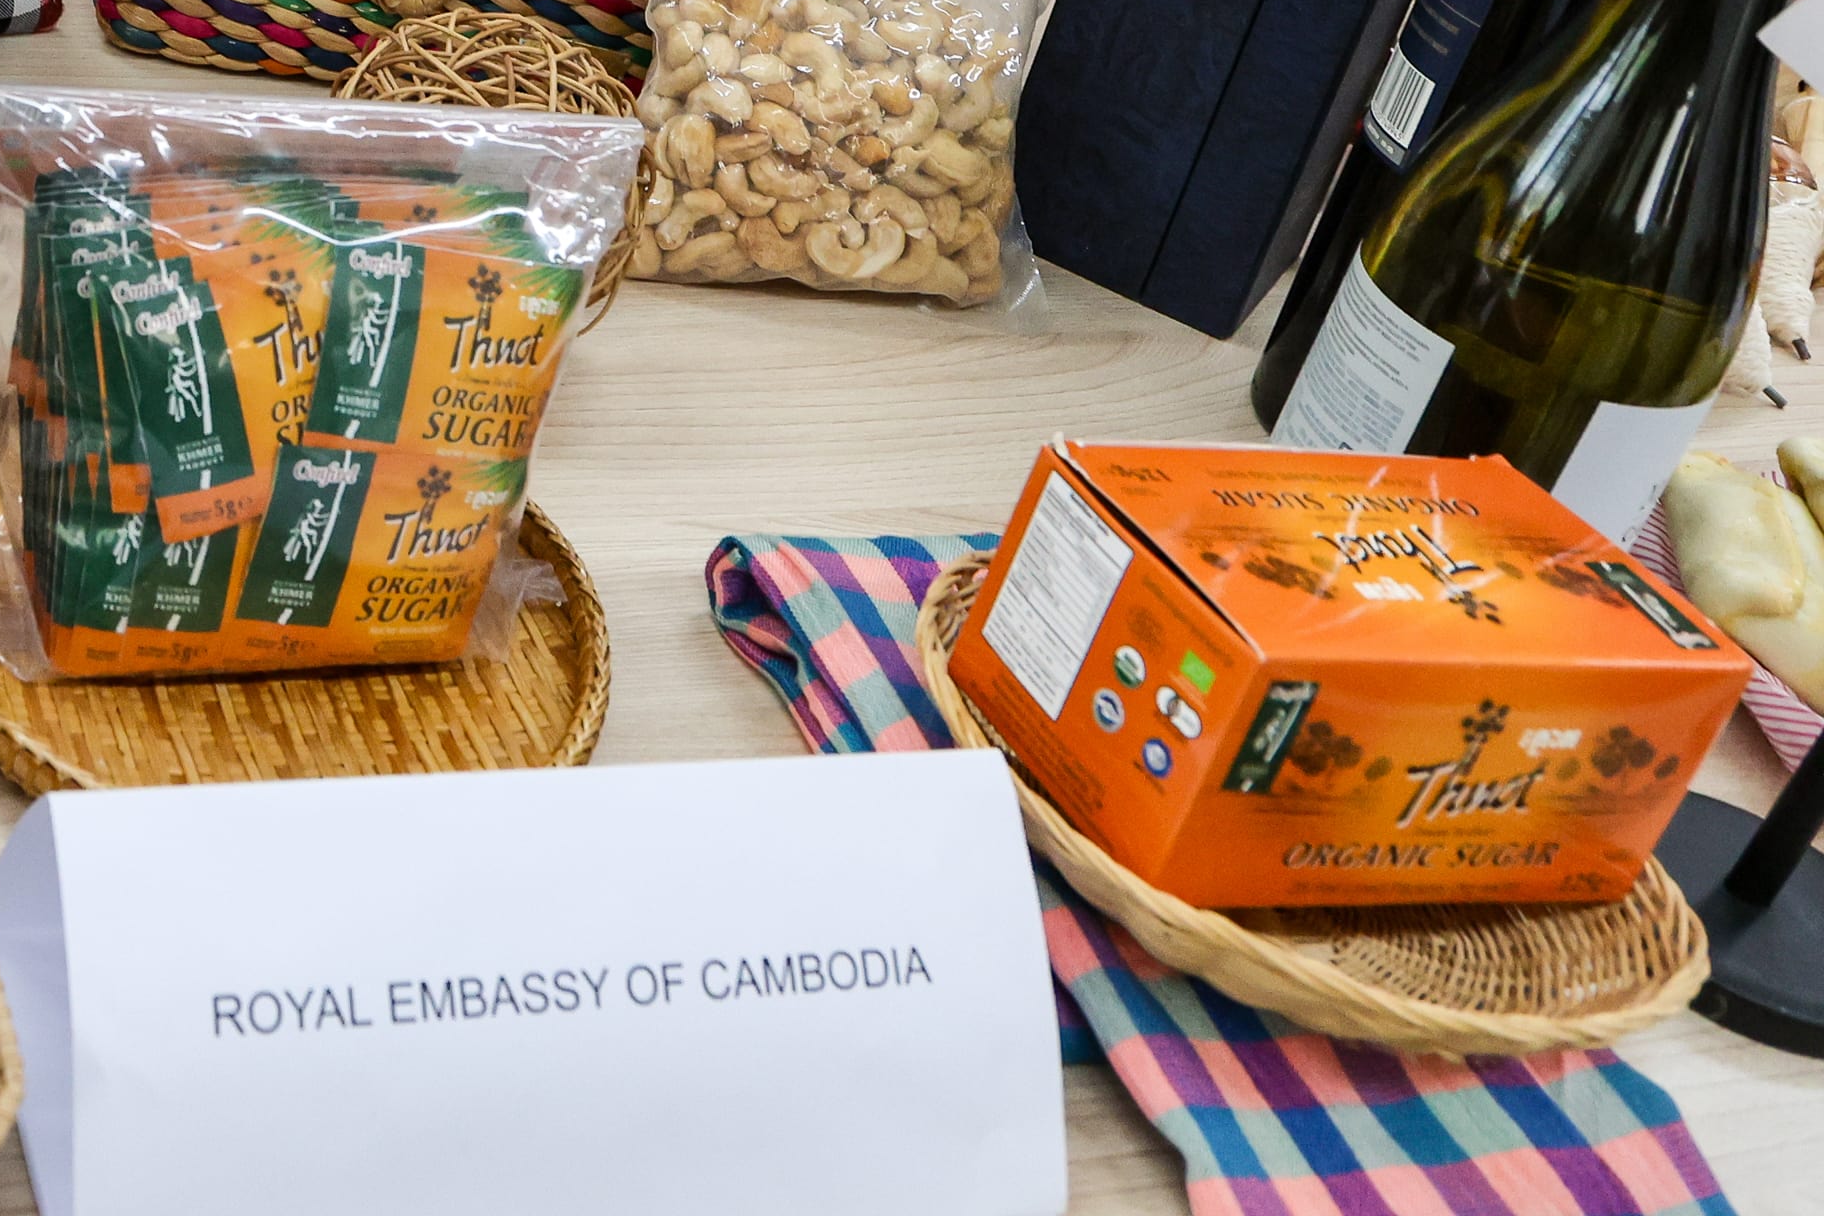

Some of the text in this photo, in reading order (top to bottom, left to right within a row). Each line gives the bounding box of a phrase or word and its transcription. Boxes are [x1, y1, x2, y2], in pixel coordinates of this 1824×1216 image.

[443, 314, 545, 373] Thnot
[1212, 488, 1480, 517] ORGANIC SUGAR
[1282, 841, 1560, 870] ORGANIC SUGAR
[210, 945, 934, 1037] ROYAL EMBASSY OF CAMBODIA
